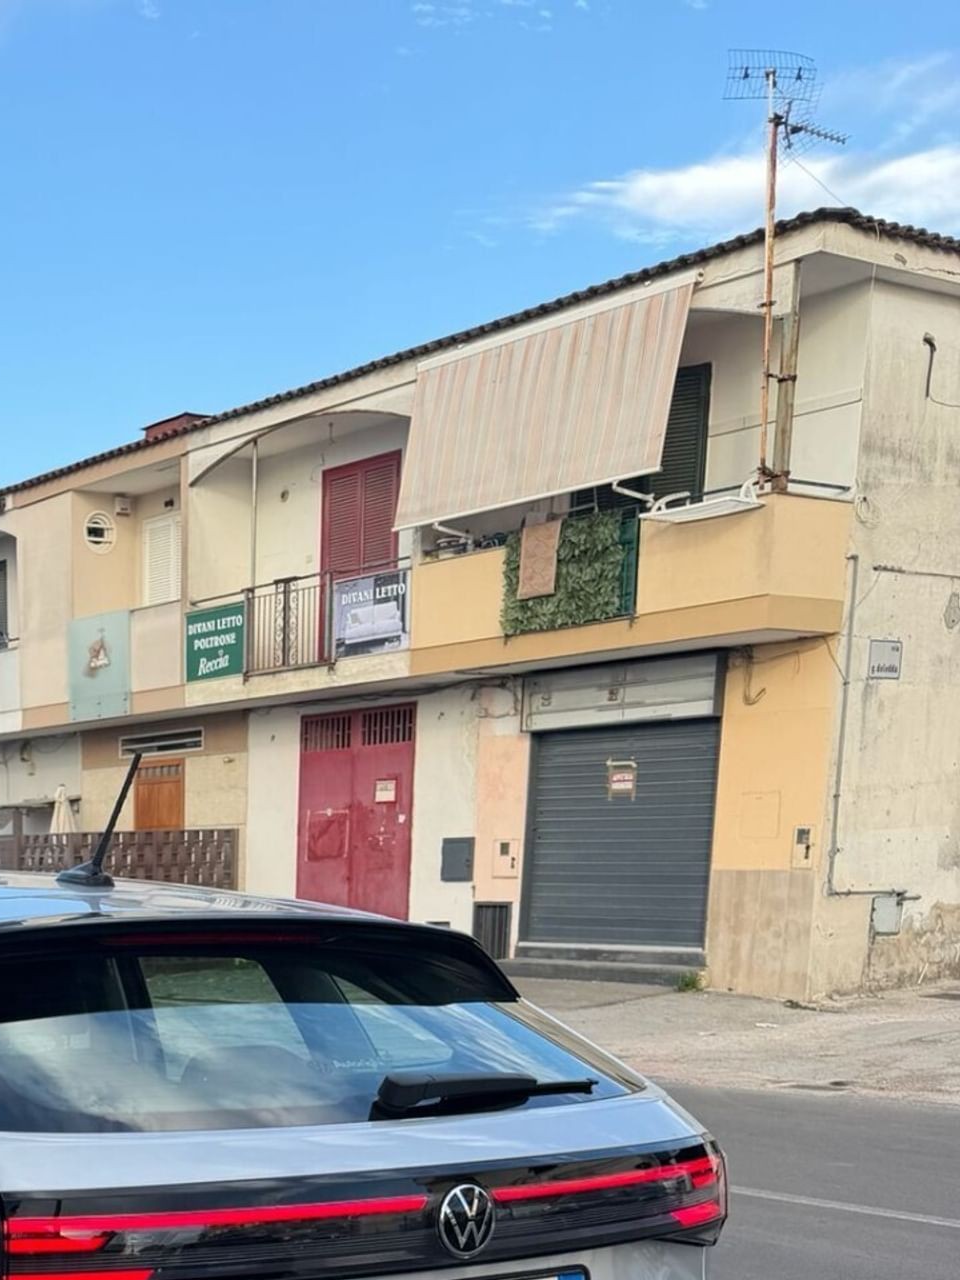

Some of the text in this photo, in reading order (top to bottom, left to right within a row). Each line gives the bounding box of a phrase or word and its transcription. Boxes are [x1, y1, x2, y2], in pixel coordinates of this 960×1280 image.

[342, 582, 405, 605] DIVANI LETTO
[188, 614, 243, 635] DIVANI LETTO
[194, 632, 236, 651] POLTRONE
